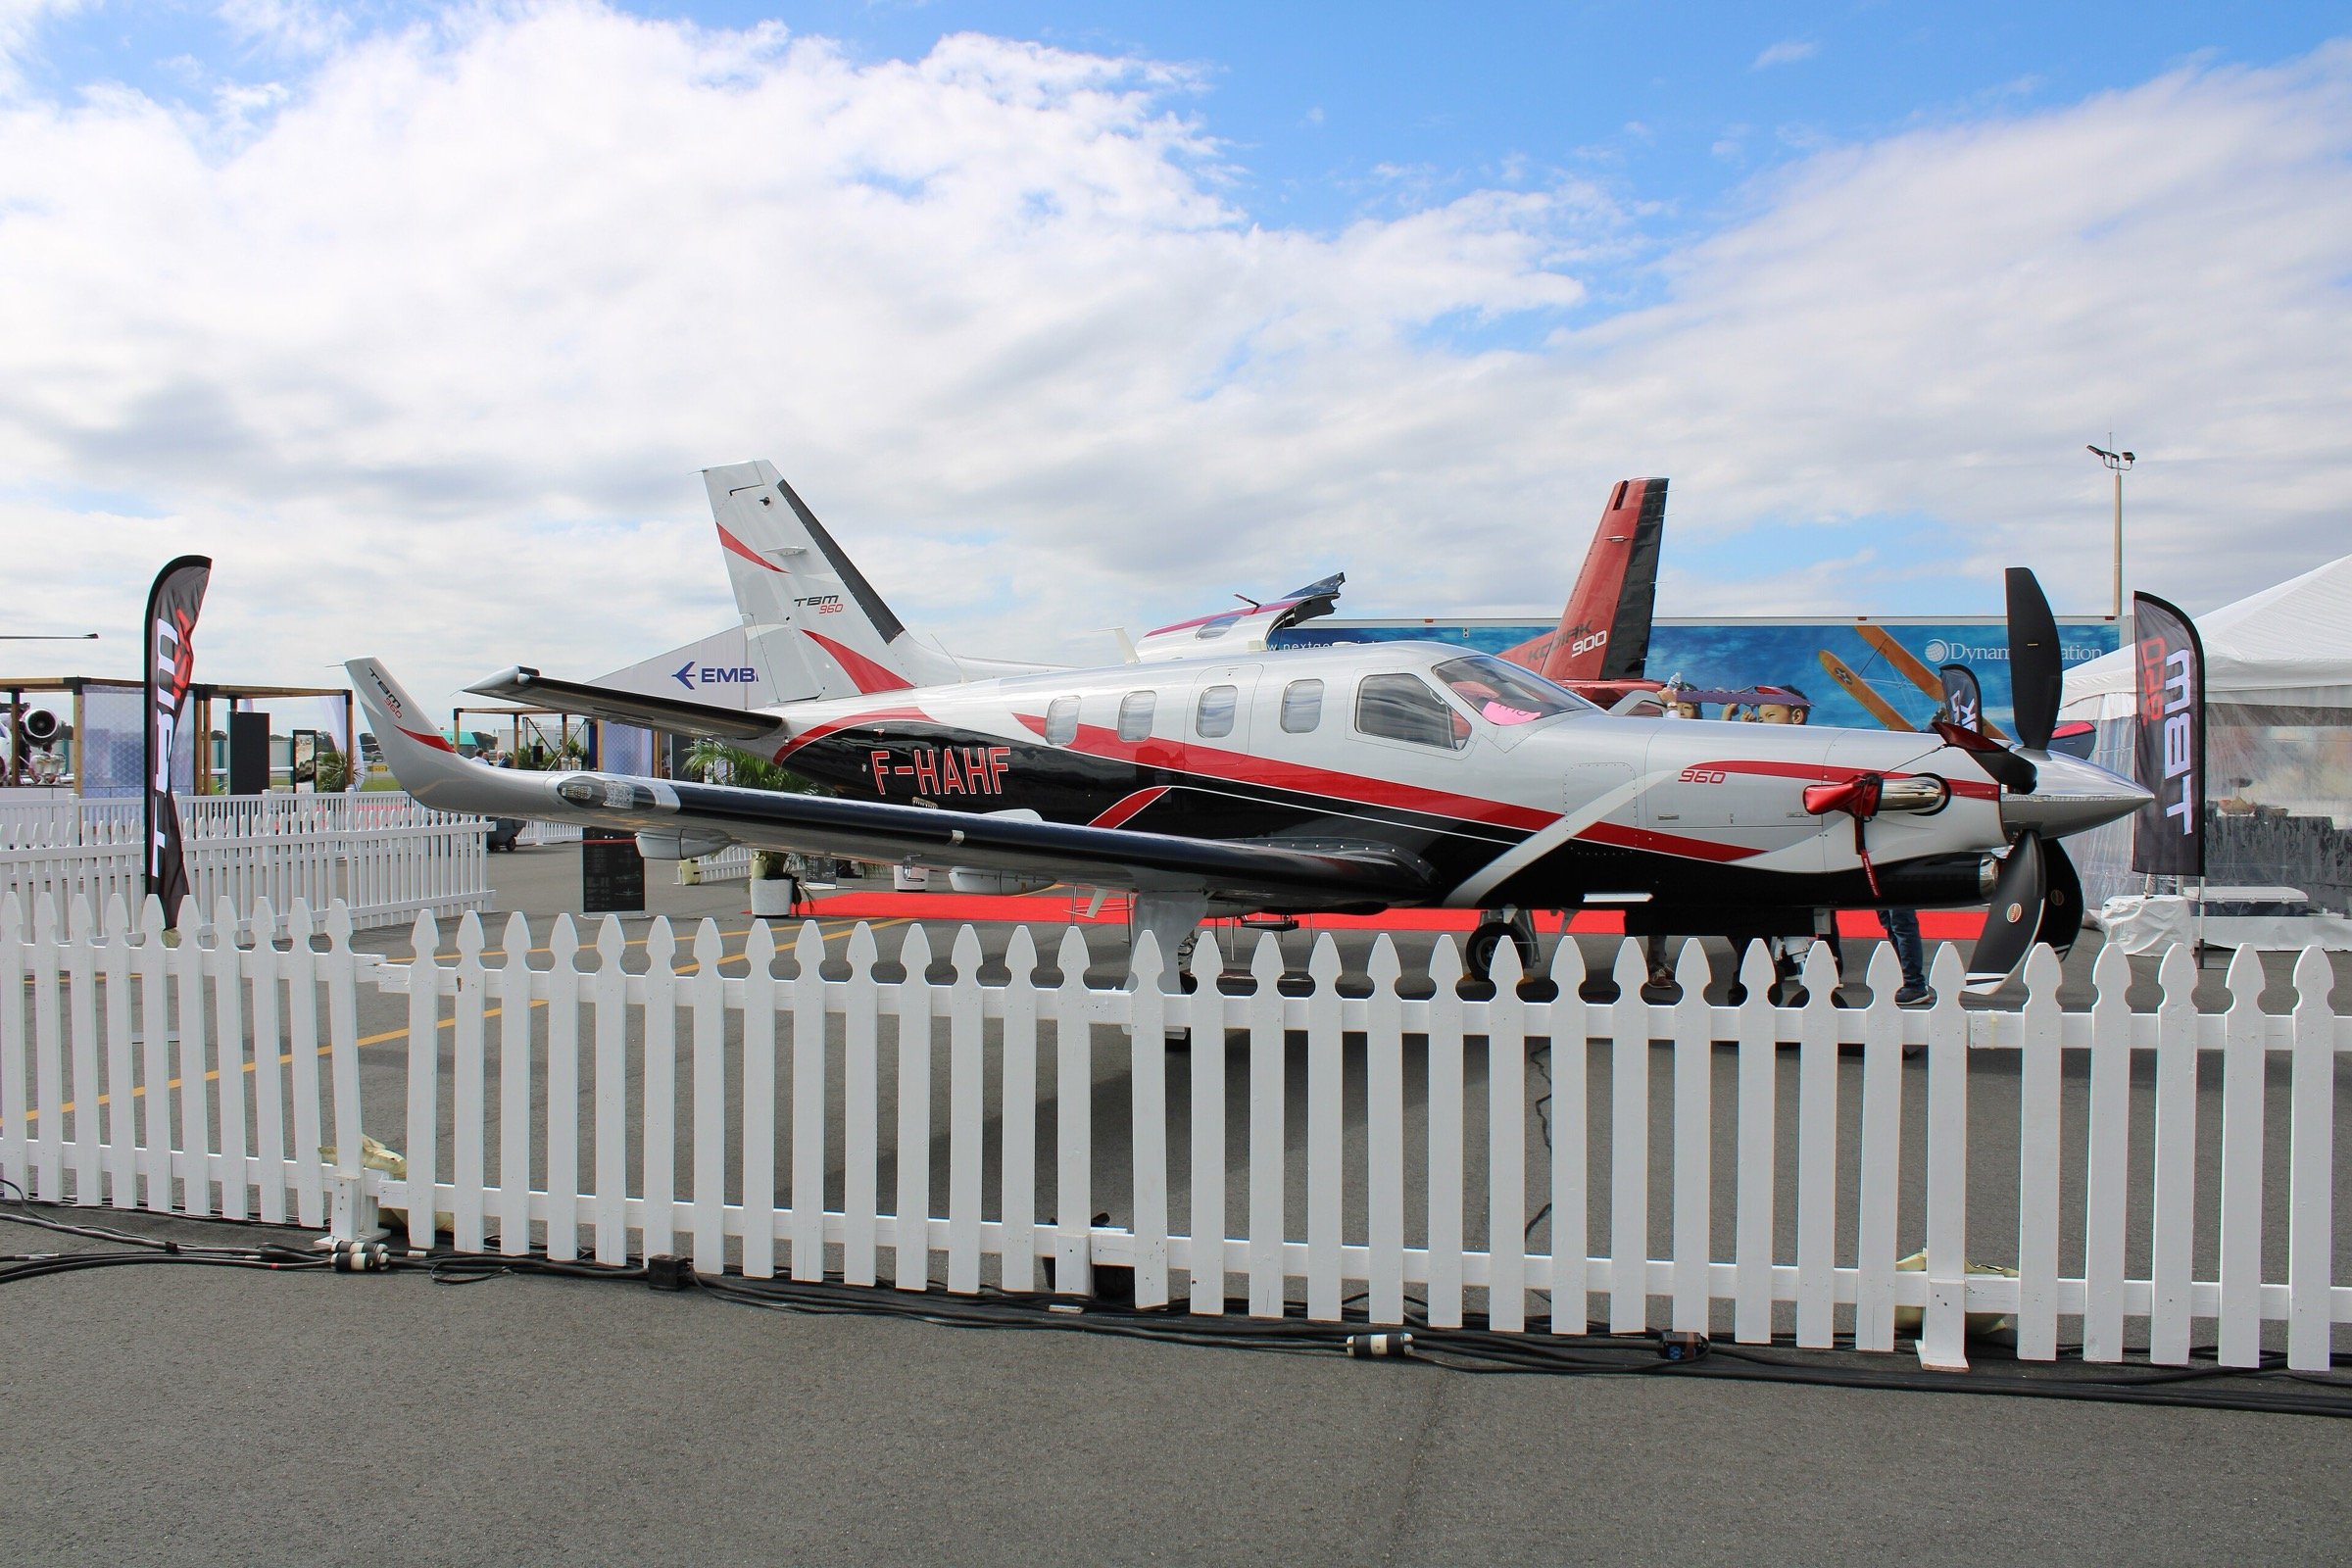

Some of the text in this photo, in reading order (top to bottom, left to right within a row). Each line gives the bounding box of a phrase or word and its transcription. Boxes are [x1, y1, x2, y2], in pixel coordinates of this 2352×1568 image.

[794, 595, 839, 607] TBM
[818, 604, 844, 613] 960
[1572, 630, 1607, 658] 900
[1950, 644, 2102, 663] Dynam ation
[701, 667, 759, 682] EMB
[369, 666, 402, 709] TBM
[384, 698, 403, 719] 960
[870, 747, 1010, 795] F-HAHF
[1678, 770, 1726, 784] 960
